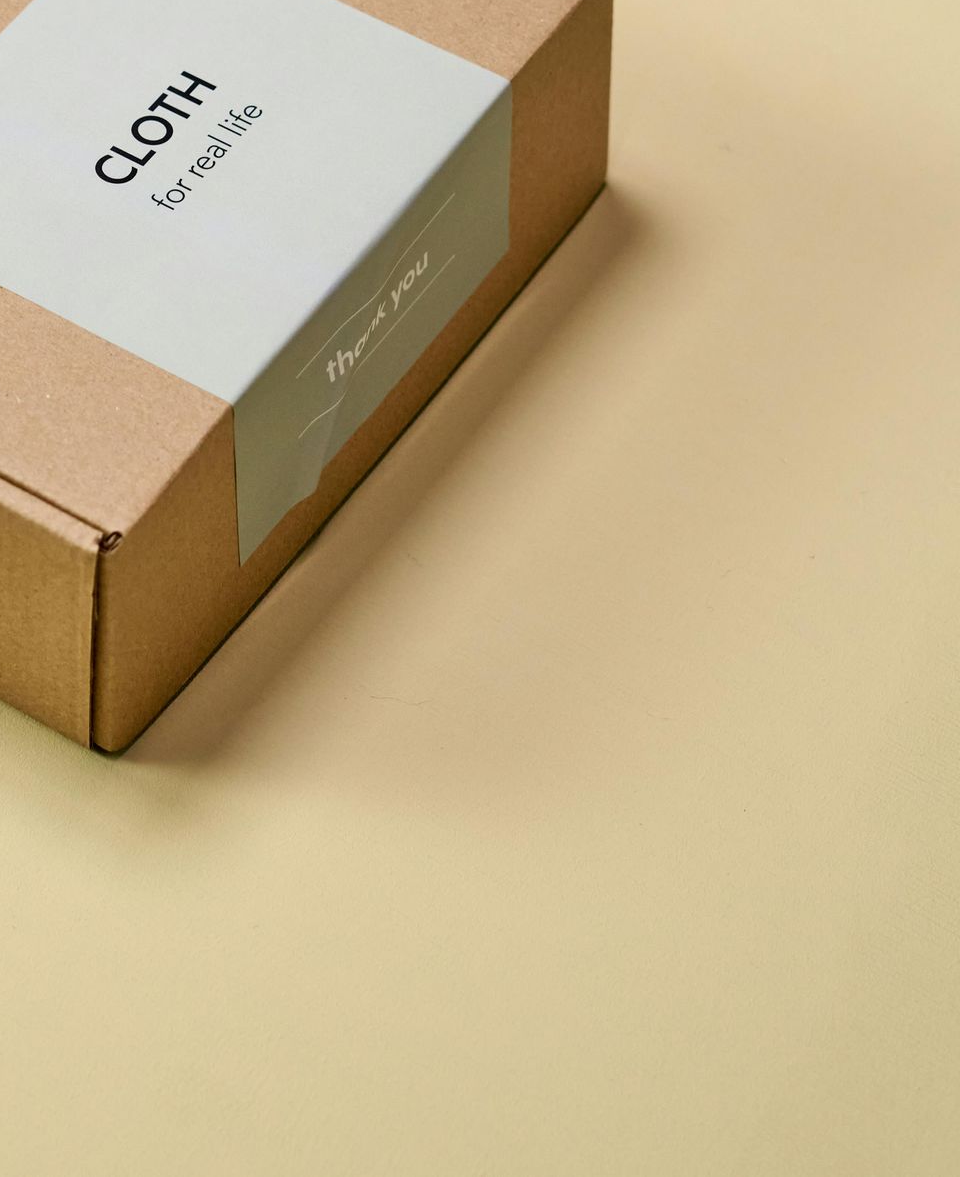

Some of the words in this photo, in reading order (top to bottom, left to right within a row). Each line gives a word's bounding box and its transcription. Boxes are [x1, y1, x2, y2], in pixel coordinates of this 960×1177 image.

[95, 70, 217, 184] CLOTH
[151, 178, 192, 211] for
[188, 134, 232, 178] real
[217, 104, 263, 136] life
[326, 301, 386, 383] thank
[391, 251, 428, 311] you
